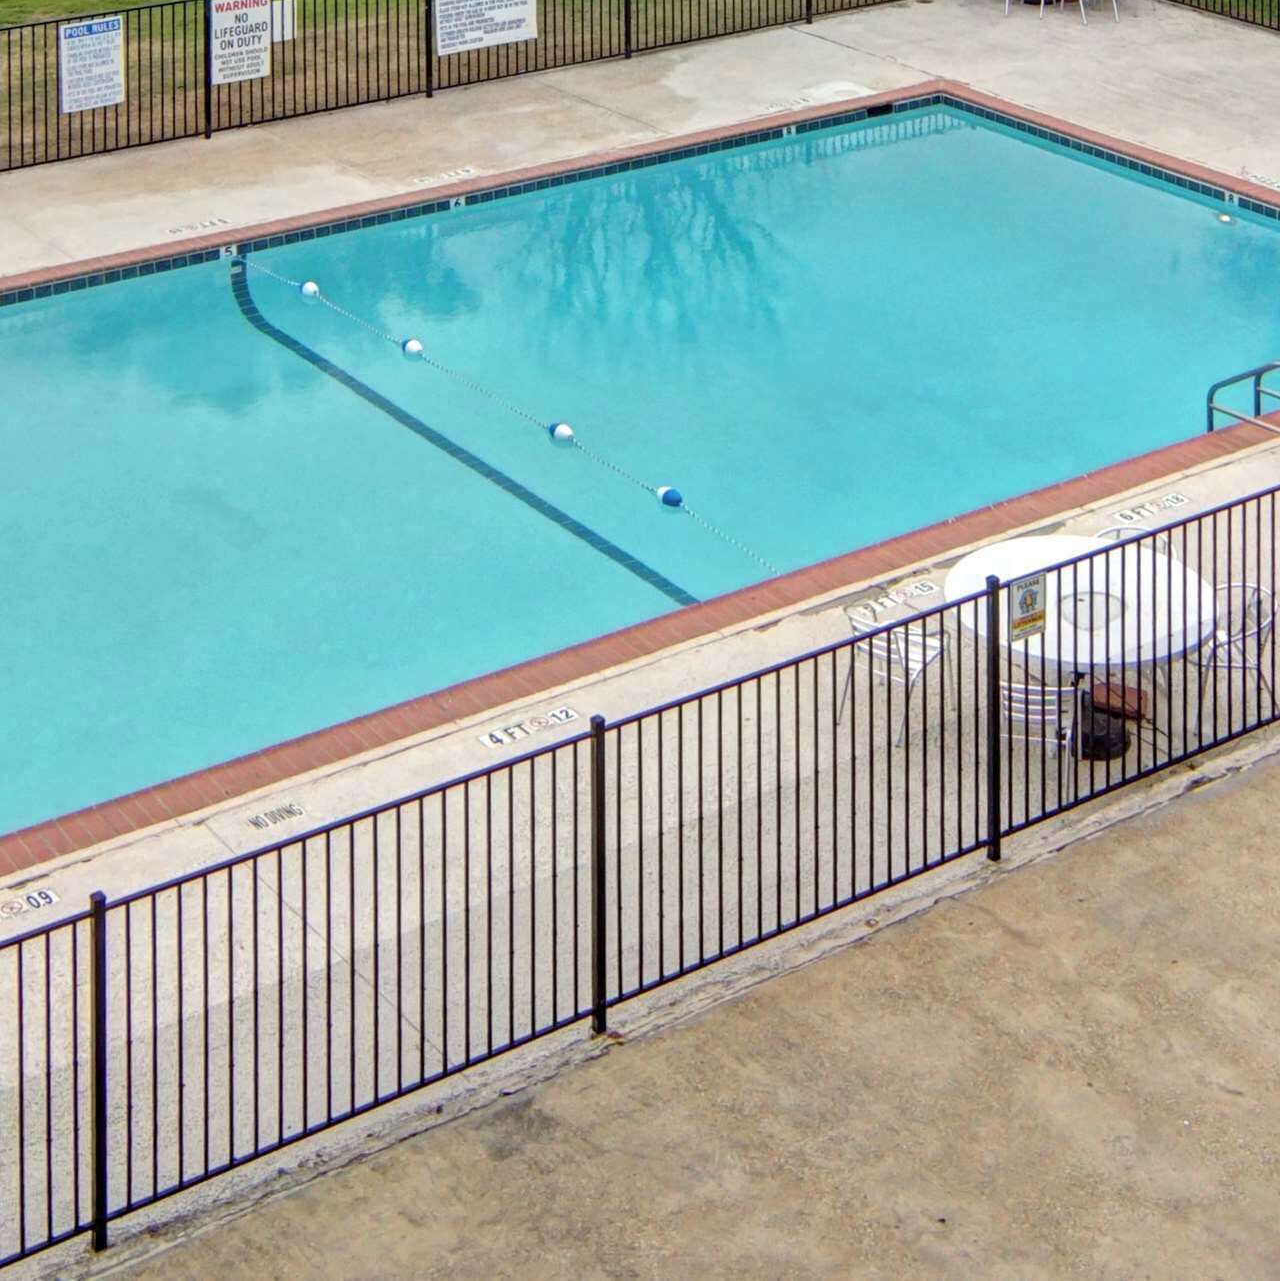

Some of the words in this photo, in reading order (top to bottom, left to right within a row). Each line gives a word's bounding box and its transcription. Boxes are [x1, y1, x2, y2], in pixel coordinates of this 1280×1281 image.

[234, 13, 248, 24] NO
[65, 26, 90, 38] POOL
[92, 20, 120, 33] RULES
[215, 21, 268, 39] LIFEGUARD
[220, 39, 234, 51] ON
[237, 34, 263, 48] DUTY
[489, 732, 505, 746] 4
[503, 722, 531, 740] FT
[247, 816, 270, 829] NO
[263, 803, 303, 824] DIVING
